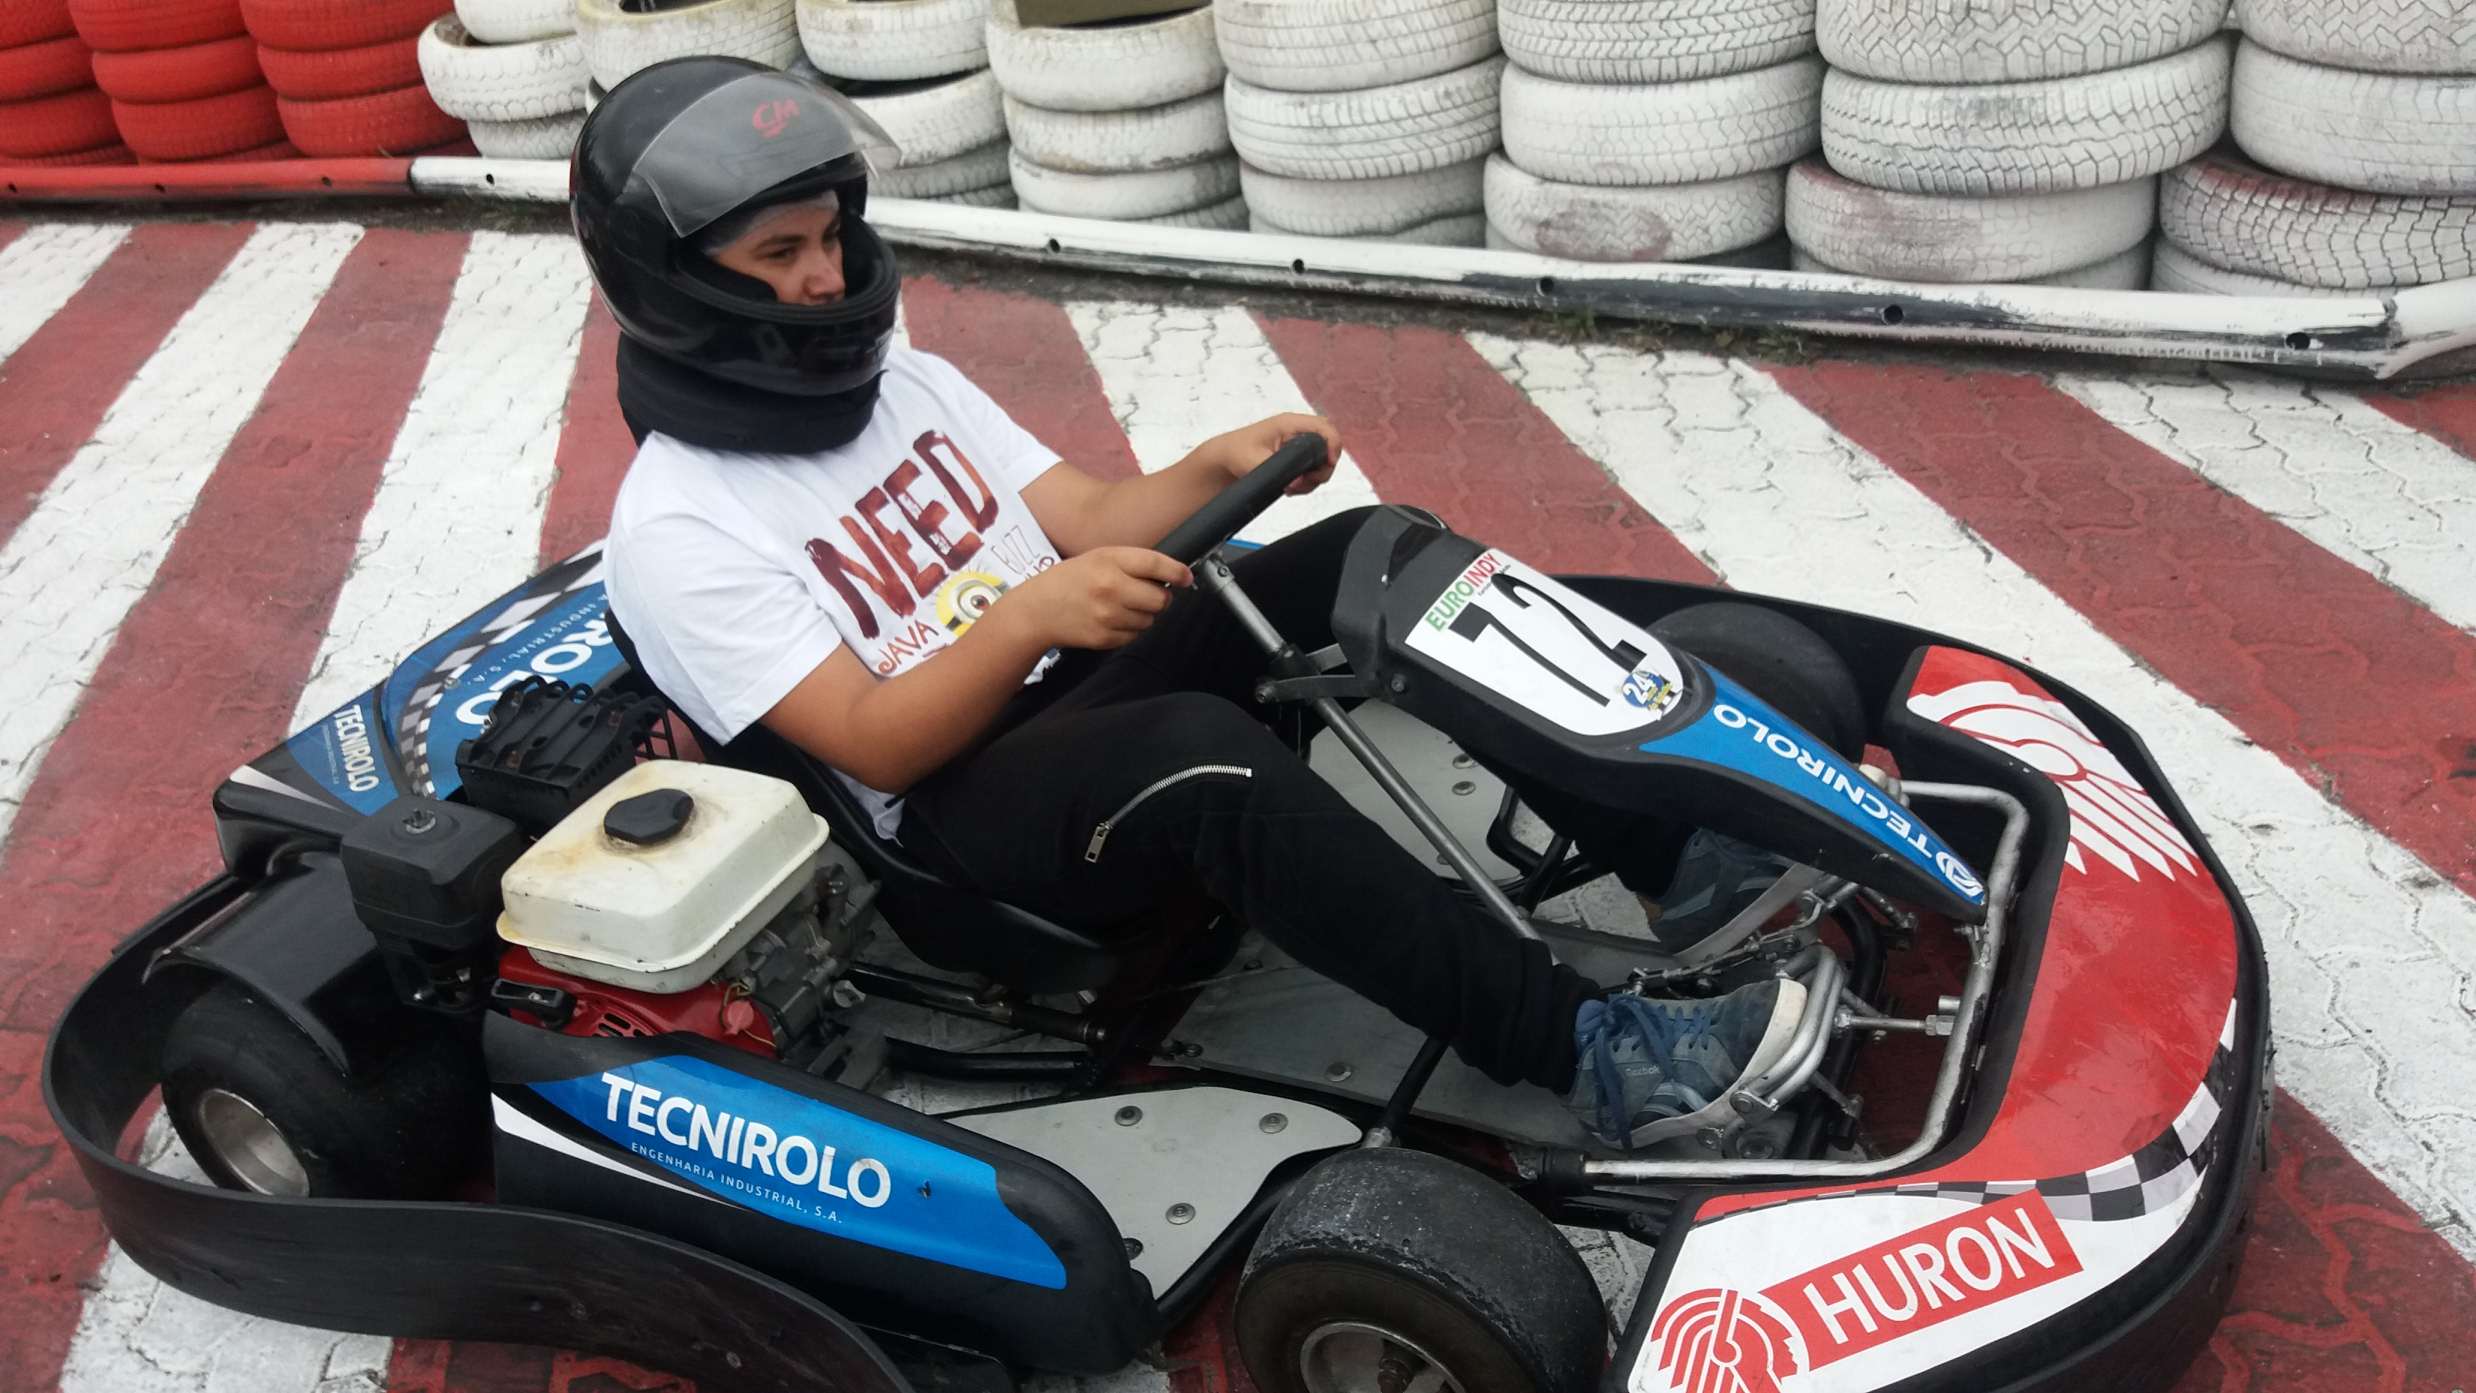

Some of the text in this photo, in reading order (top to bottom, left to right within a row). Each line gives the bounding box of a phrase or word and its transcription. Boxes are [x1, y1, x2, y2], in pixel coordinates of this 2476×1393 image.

[804, 429, 999, 640] NEED
[878, 619, 940, 674] JAVA
[1425, 553, 1502, 631] EUROINDY
[1448, 573, 1647, 707] 72
[456, 612, 615, 726] ROLO
[1622, 673, 1657, 705] 24
[334, 704, 379, 792] TECNIROLO
[1713, 704, 1932, 858] TECNIROLO
[601, 1071, 891, 1208] TECNIROLO
[631, 1141, 843, 1224] ENGENHARIA INDUSTRIAL, S.A.
[1802, 1207, 2055, 1344] HURON
